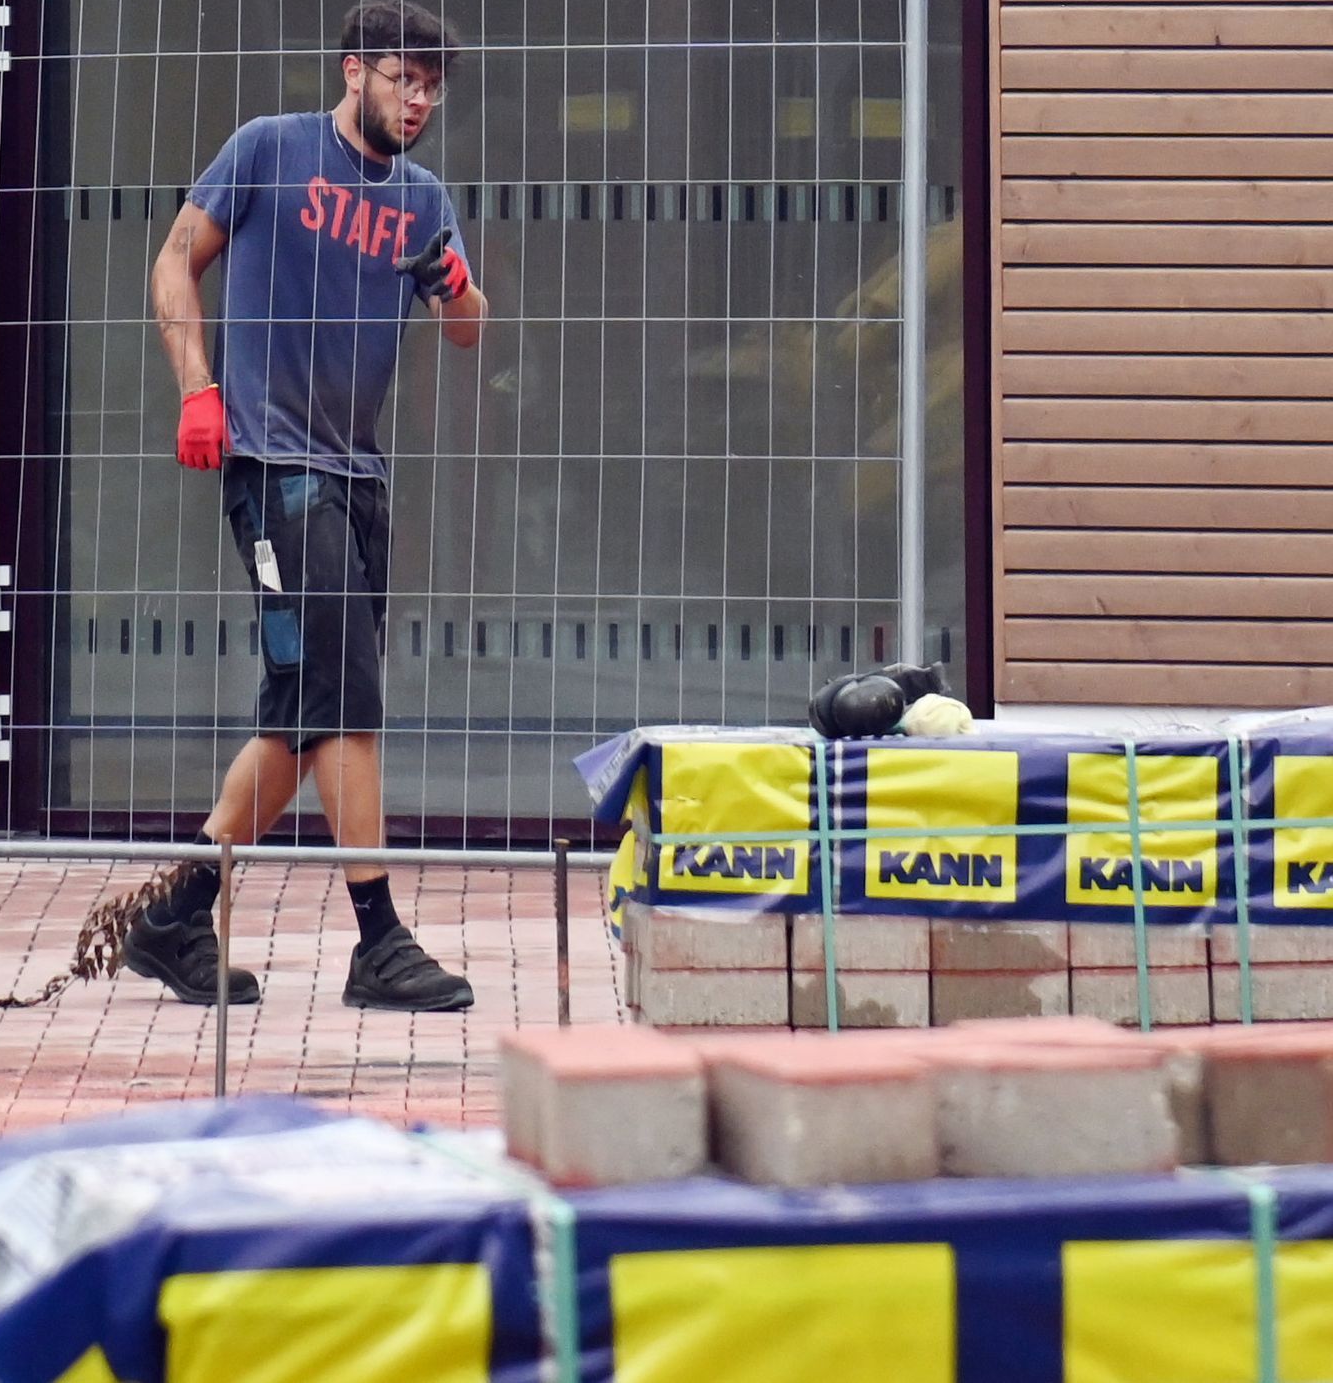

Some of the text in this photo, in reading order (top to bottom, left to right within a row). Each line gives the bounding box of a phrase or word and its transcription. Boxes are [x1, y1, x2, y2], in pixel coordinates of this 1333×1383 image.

[300, 175, 416, 265] STAFF
[673, 844, 795, 880] KANN
[879, 850, 1002, 888] KANN
[1079, 856, 1203, 893] KANN
[1287, 861, 1333, 894] KA
